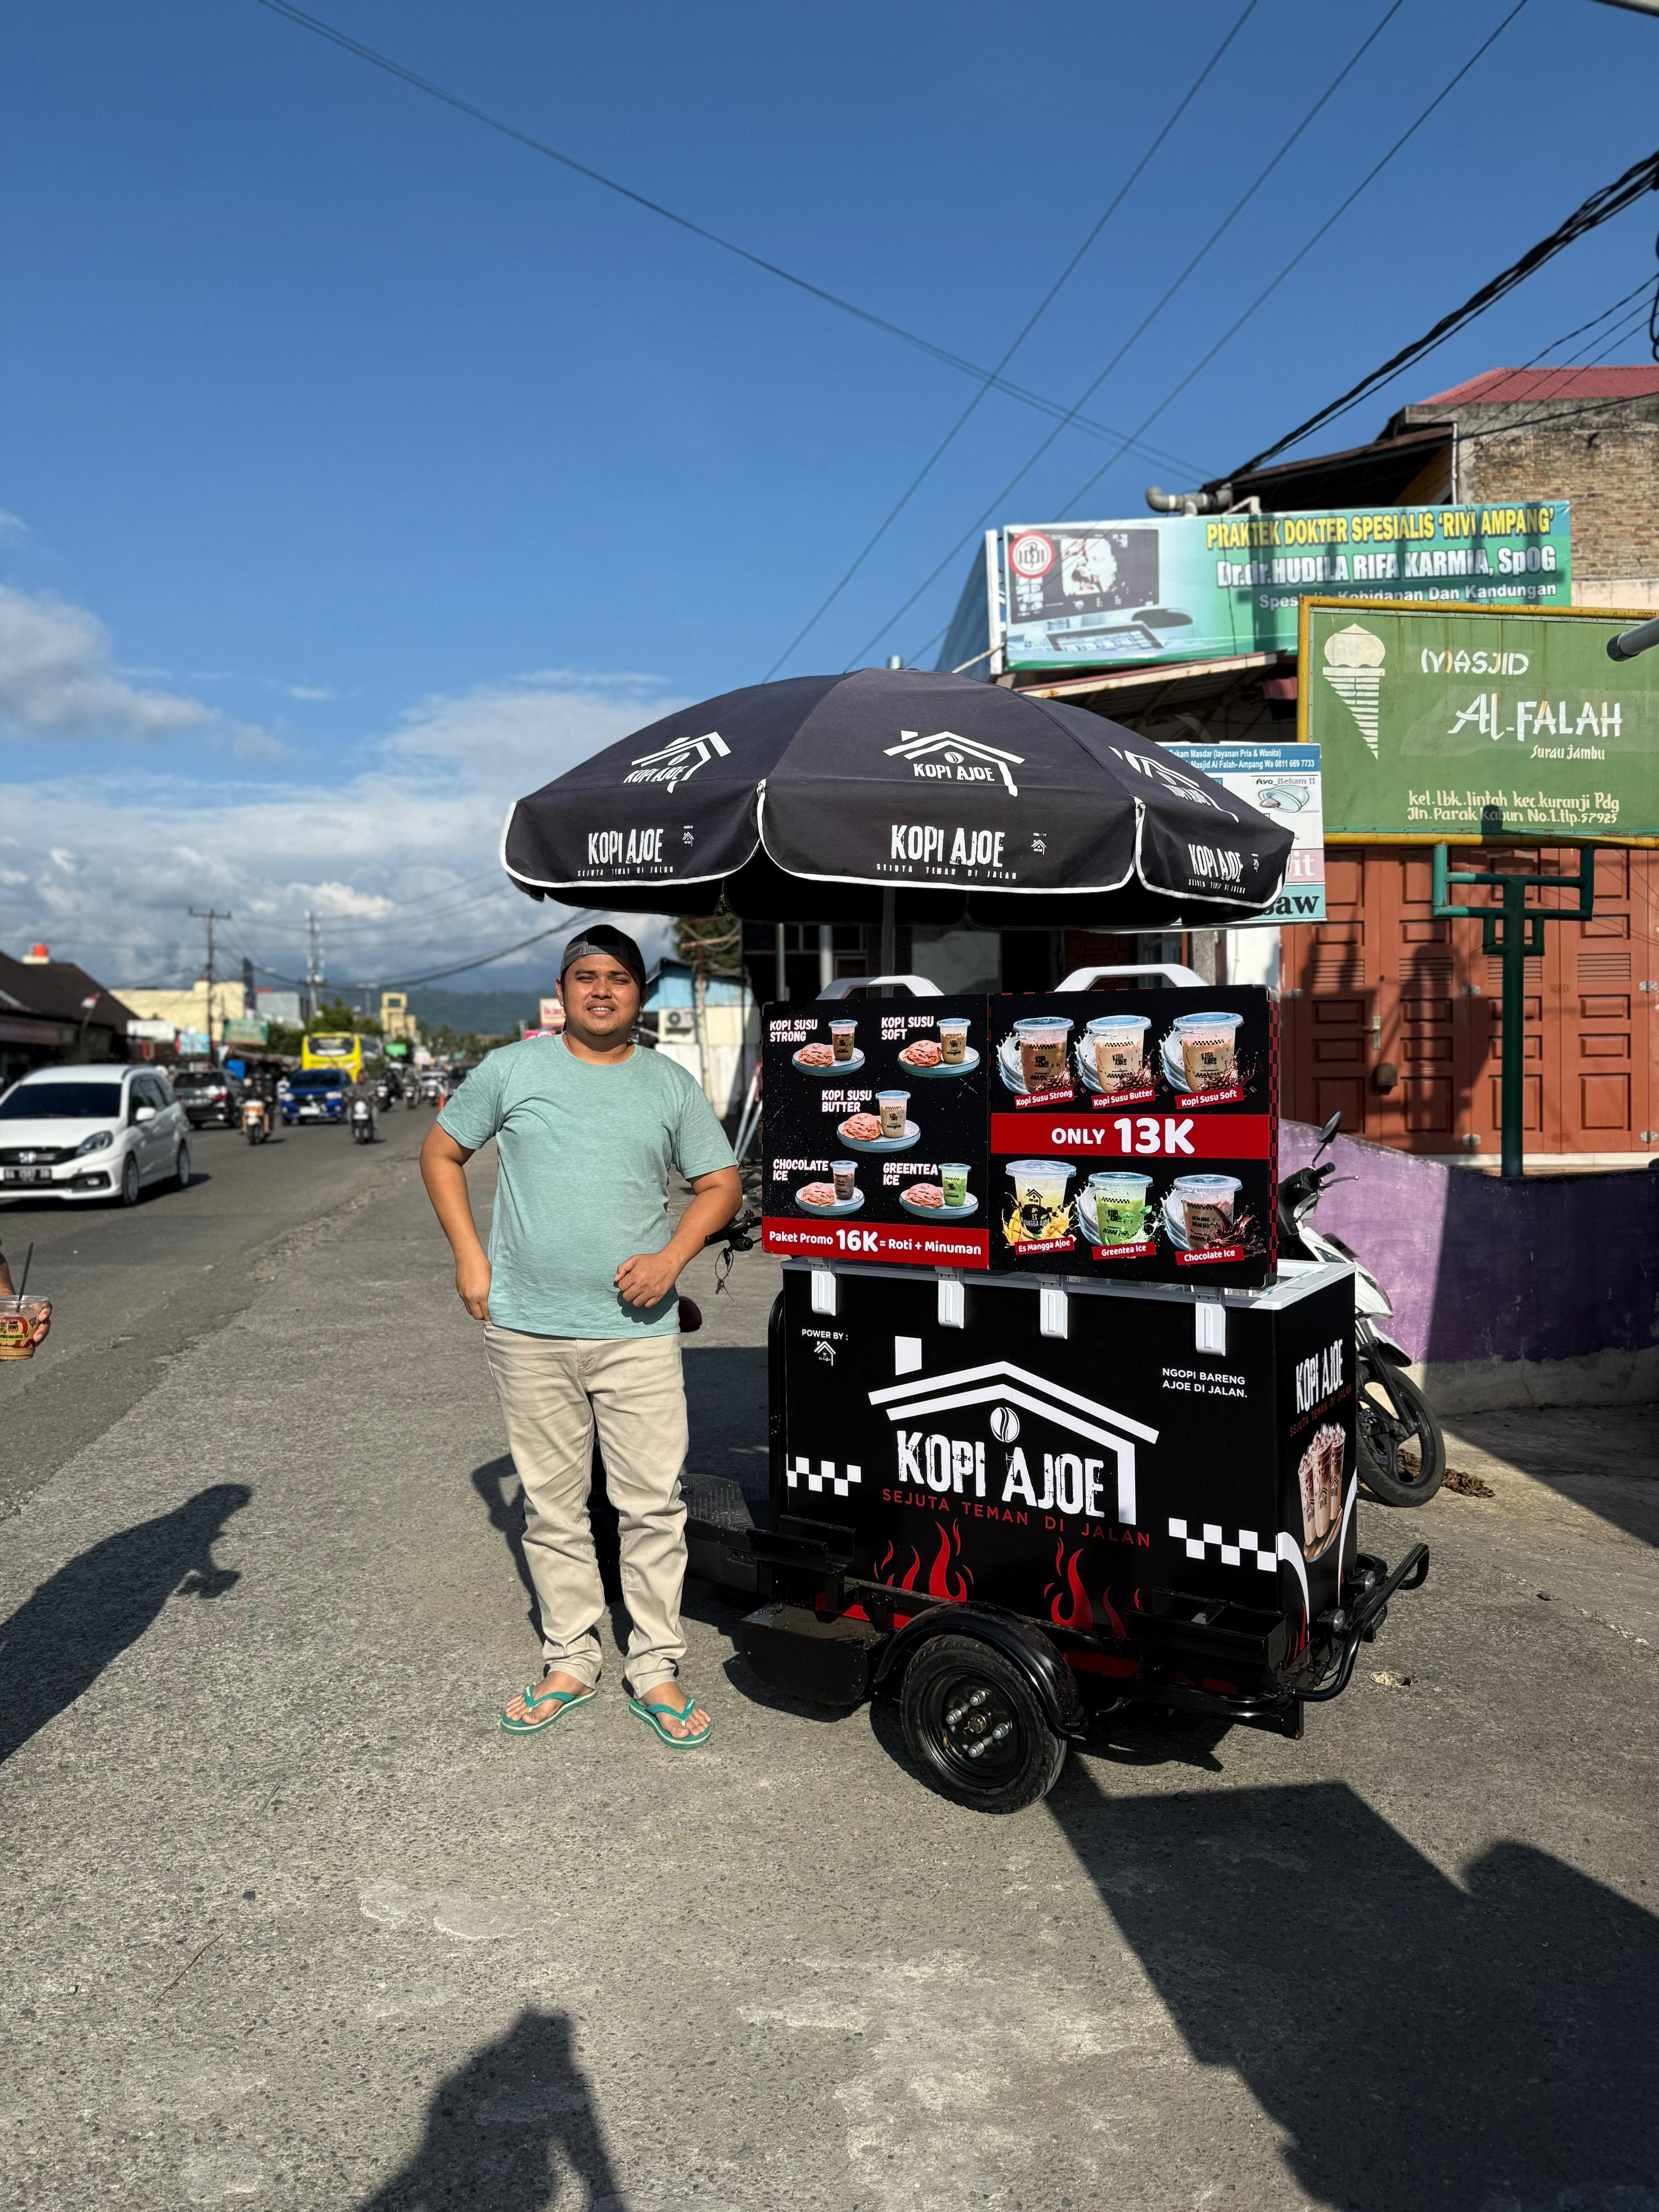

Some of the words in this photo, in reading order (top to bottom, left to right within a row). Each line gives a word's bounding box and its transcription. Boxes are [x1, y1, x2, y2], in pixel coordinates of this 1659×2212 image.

[1206, 518, 1280, 549] PRAKTEK
[1284, 515, 1348, 545] DOKTER
[1352, 512, 1434, 542] SPESIALIS
[1353, 552, 1398, 581] RIFA
[1405, 549, 1494, 579] KARMIA,
[1498, 545, 1557, 576] SpOG
[1429, 585, 1459, 600] Dan
[1465, 582, 1557, 604] Kandungan
[1421, 648, 1529, 675] MASJID
[1191, 749, 1213, 758] Masdar
[1213, 749, 1239, 759] (layanan
[1259, 749, 1281, 758] Wanita)
[1530, 745, 1564, 759] Surau
[914, 763, 951, 779] KOPI
[957, 766, 995, 781] AJOE
[1191, 760, 1211, 770] Masjid
[1238, 760, 1263, 770] Ampang
[623, 768, 655, 783] KOPI
[650, 766, 689, 782] AJOE
[1595, 792, 1619, 811] Pdg
[589, 831, 623, 865] KOPI
[626, 829, 664, 864] AJOE
[891, 825, 944, 862] KOPI
[950, 827, 1005, 867] AJOE
[877, 864, 913, 873] SEJUTA
[926, 866, 956, 876] TEMAN
[968, 869, 978, 877] DI
[986, 870, 1017, 879] JALAN
[1188, 844, 1219, 878] KOPI
[1217, 848, 1243, 882] AJOE
[770, 1020, 791, 1031] KOPI
[794, 1019, 818, 1030] SUSU
[881, 1017, 904, 1029] KOPI
[908, 1016, 934, 1028] SUSU
[769, 1030, 807, 1042] STRONG
[882, 1028, 908, 1040] SOFT
[822, 1090, 844, 1101] KOPI
[847, 1090, 872, 1101] SUSU
[1015, 1095, 1030, 1107] Kopi
[1032, 1093, 1048, 1103] Susu
[1049, 1089, 1073, 1102] Strong
[1093, 1096, 1109, 1108] Kopi
[1111, 1094, 1128, 1103] Susu
[1129, 1089, 1153, 1100] Butter
[1181, 1095, 1199, 1108] Kopi
[1200, 1093, 1219, 1103] Susu
[1221, 1089, 1237, 1100] Soft
[822, 1101, 861, 1112] BUTTER
[1051, 1128, 1105, 1145] ONLY
[1114, 1118, 1195, 1154] 13K
[773, 1159, 829, 1171] CHOCOLATE
[883, 1162, 938, 1176] GREENTEA
[773, 1170, 788, 1182] ICE
[883, 1175, 900, 1186] ICE
[769, 1230, 798, 1243] Paket
[800, 1232, 833, 1245] Promo
[835, 1228, 878, 1253] 16K
[888, 1238, 912, 1251] Roti
[925, 1240, 982, 1255] Minuman
[1018, 1244, 1026, 1253] Es
[1028, 1241, 1052, 1254] Mangga
[1054, 1239, 1071, 1250] Ajoe
[1101, 1246, 1134, 1257] Greentea
[1135, 1244, 1146, 1254] Ice
[1184, 1250, 1222, 1262] Chocolate
[1224, 1249, 1236, 1258] Ice
[802, 1329, 831, 1338] POWER
[1162, 1368, 1196, 1379] NGOPI
[1200, 1372, 1245, 1385] BARENG
[1296, 1353, 1319, 1414] KOPI
[1322, 1339, 1343, 1399] AJOE
[1162, 1380, 1191, 1392] AJOE
[1194, 1384, 1205, 1393] DI
[1208, 1385, 1247, 1398] JALAN.
[1290, 1415, 1309, 1436] SEJUTA
[1330, 1396, 1335, 1407] DI
[1338, 1384, 1352, 1401] JALAN
[897, 1430, 986, 1497] KOPI
[1002, 1446, 1105, 1518] AJOE
[883, 1488, 950, 1512] SEJUTA
[962, 1501, 1028, 1526] TEMAN
[1045, 1516, 1063, 1532] DI
[1082, 1523, 1150, 1547] JALAN
